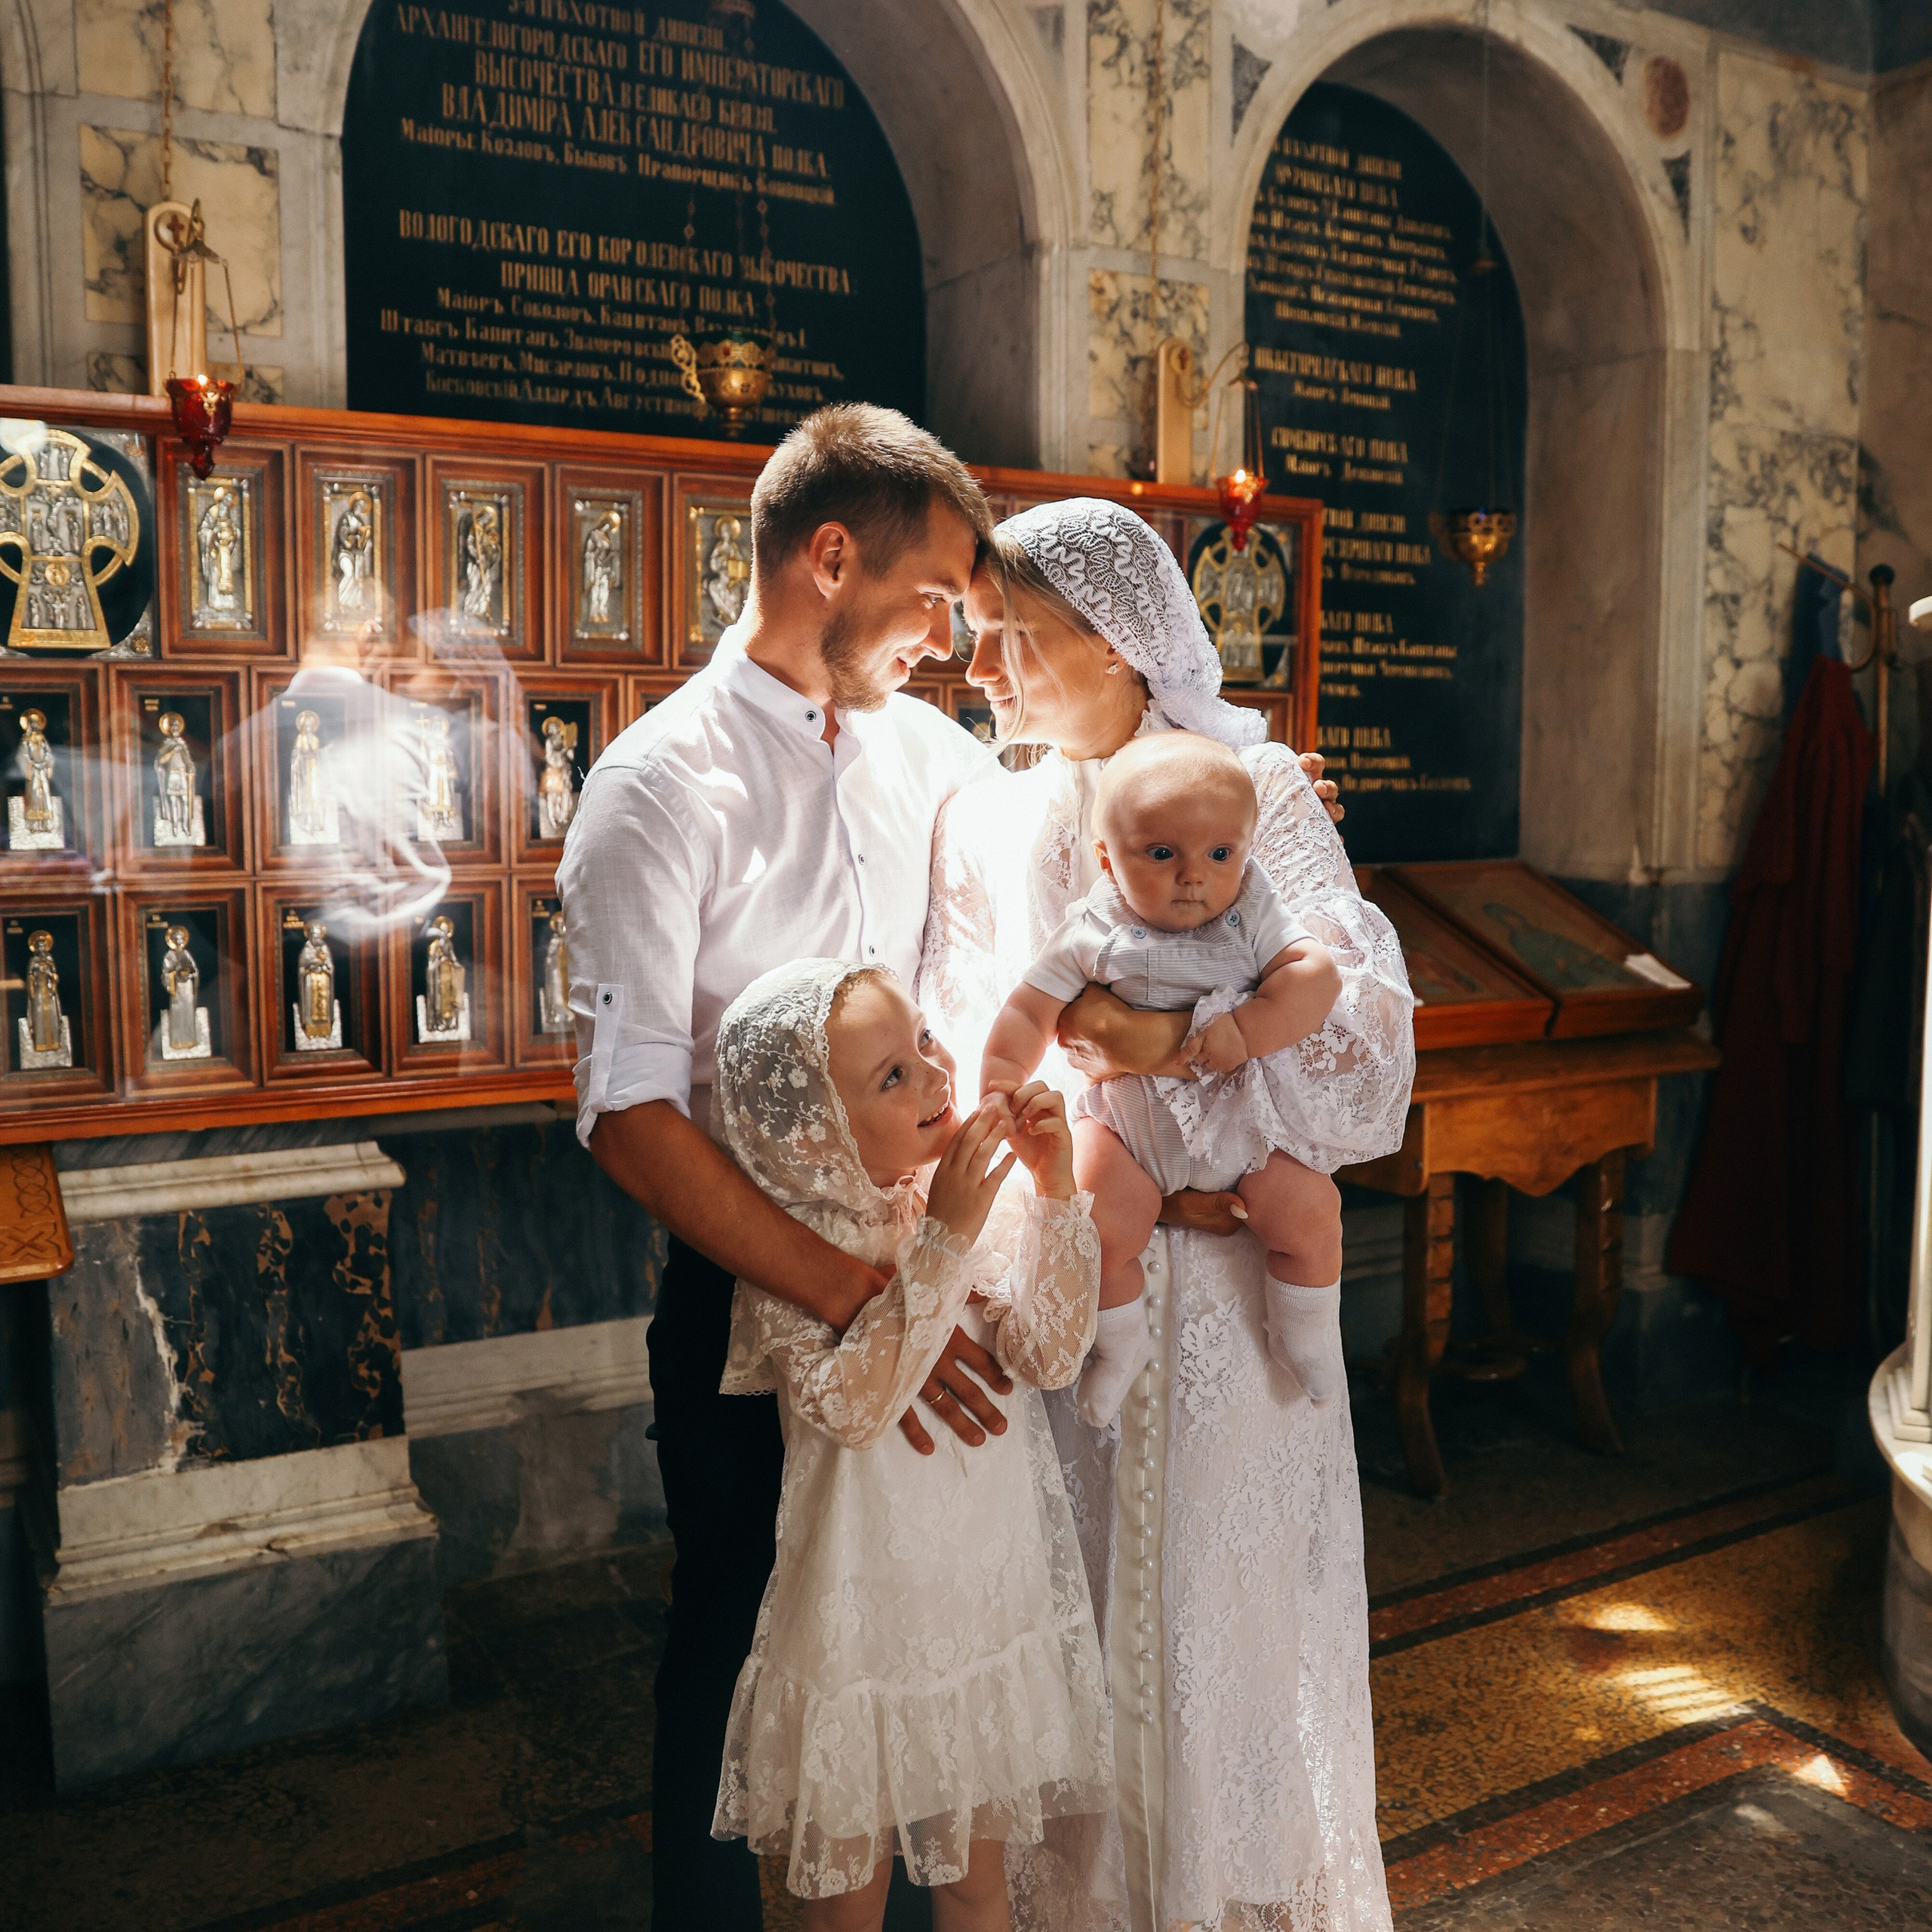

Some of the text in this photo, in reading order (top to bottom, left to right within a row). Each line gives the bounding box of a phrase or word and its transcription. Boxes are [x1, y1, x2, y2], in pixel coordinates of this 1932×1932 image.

[639, 41, 674, 77] ЕГО
[398, 209, 549, 254] ВОЛОГОДСКАГО
[556, 229, 591, 260] ЕГО
[501, 260, 580, 297] ПРИНЦА
